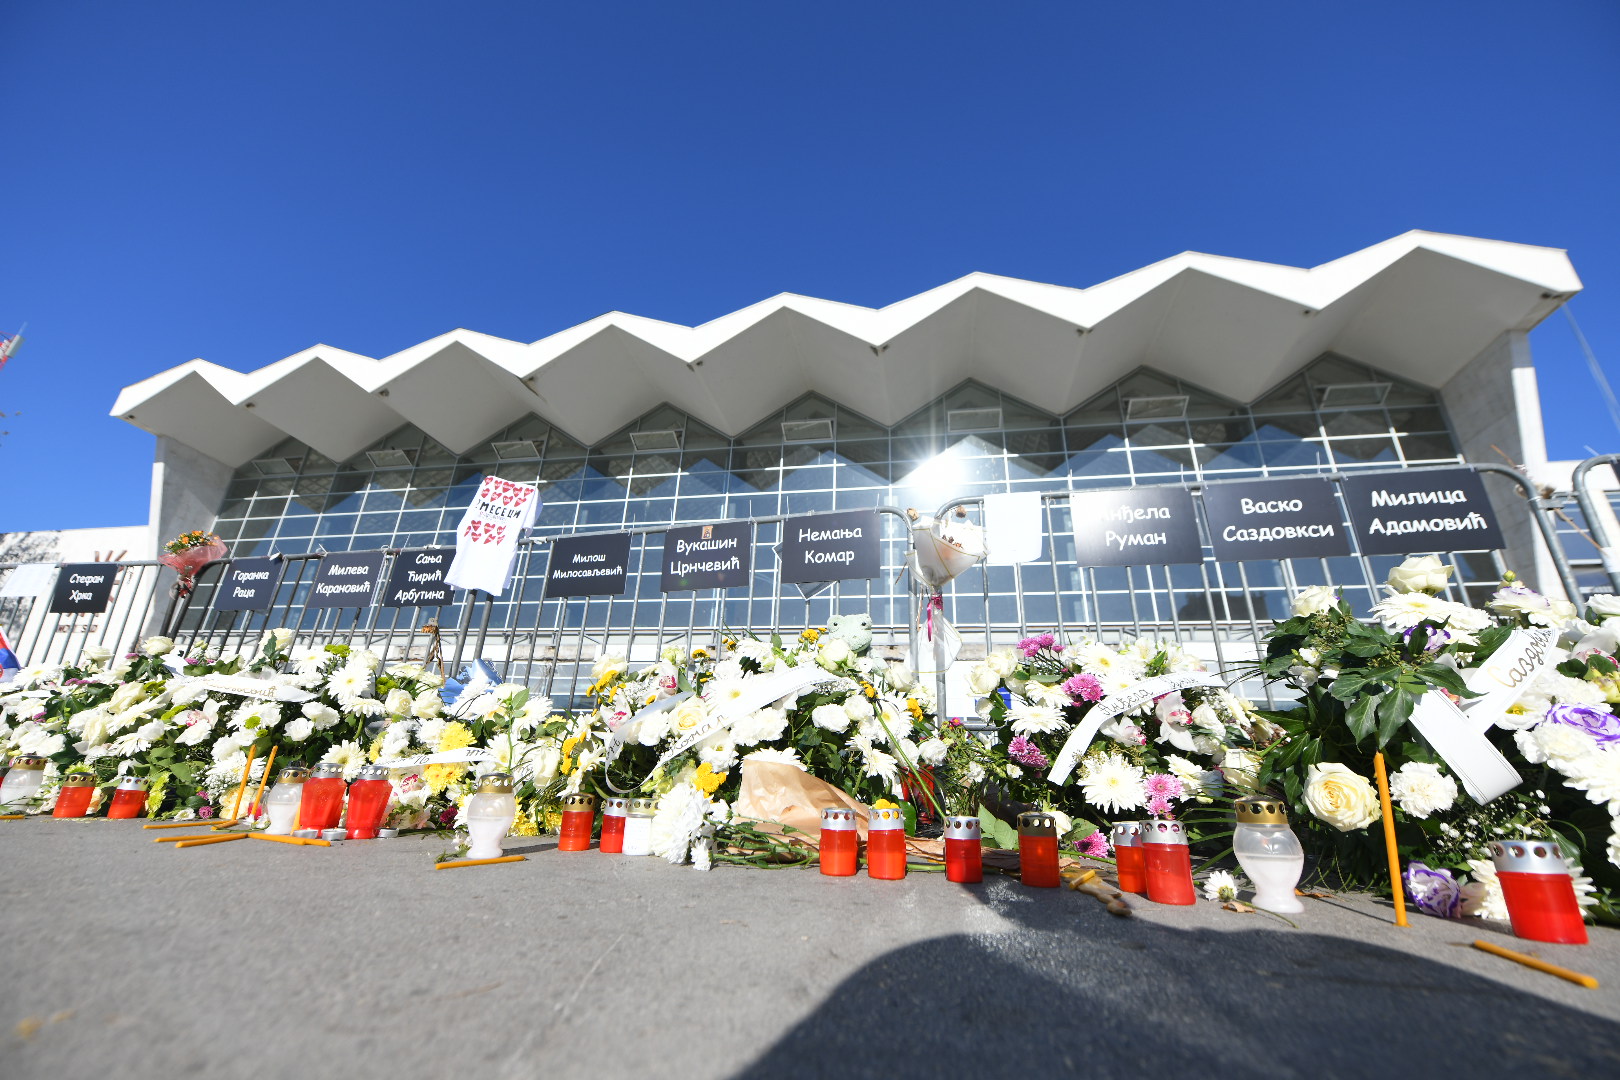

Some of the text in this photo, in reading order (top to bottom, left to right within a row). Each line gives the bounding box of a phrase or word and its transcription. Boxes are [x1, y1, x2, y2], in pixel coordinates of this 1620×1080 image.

[1240, 498, 1303, 515] Васко
[1371, 489, 1468, 509] Милица
[1368, 511, 1488, 536] Адамовић
[798, 527, 863, 543] Немања
[1105, 530, 1168, 551] Руман
[1222, 524, 1335, 543] Саздовкси
[676, 536, 738, 556] Вукашин
[415, 553, 443, 565] Сања
[572, 553, 606, 564] Милош
[804, 549, 855, 566] Комар
[327, 564, 370, 576] Милева
[552, 566, 623, 580] Милосављевић
[670, 556, 740, 578] Црнчевић
[69, 573, 105, 587] Стефан
[232, 570, 270, 584] Горанка
[407, 569, 442, 583] Ћирић
[232, 586, 256, 599] Раца
[315, 581, 371, 595] Карановић
[394, 588, 445, 603] Арбутина
[69, 589, 93, 604] Хрка
